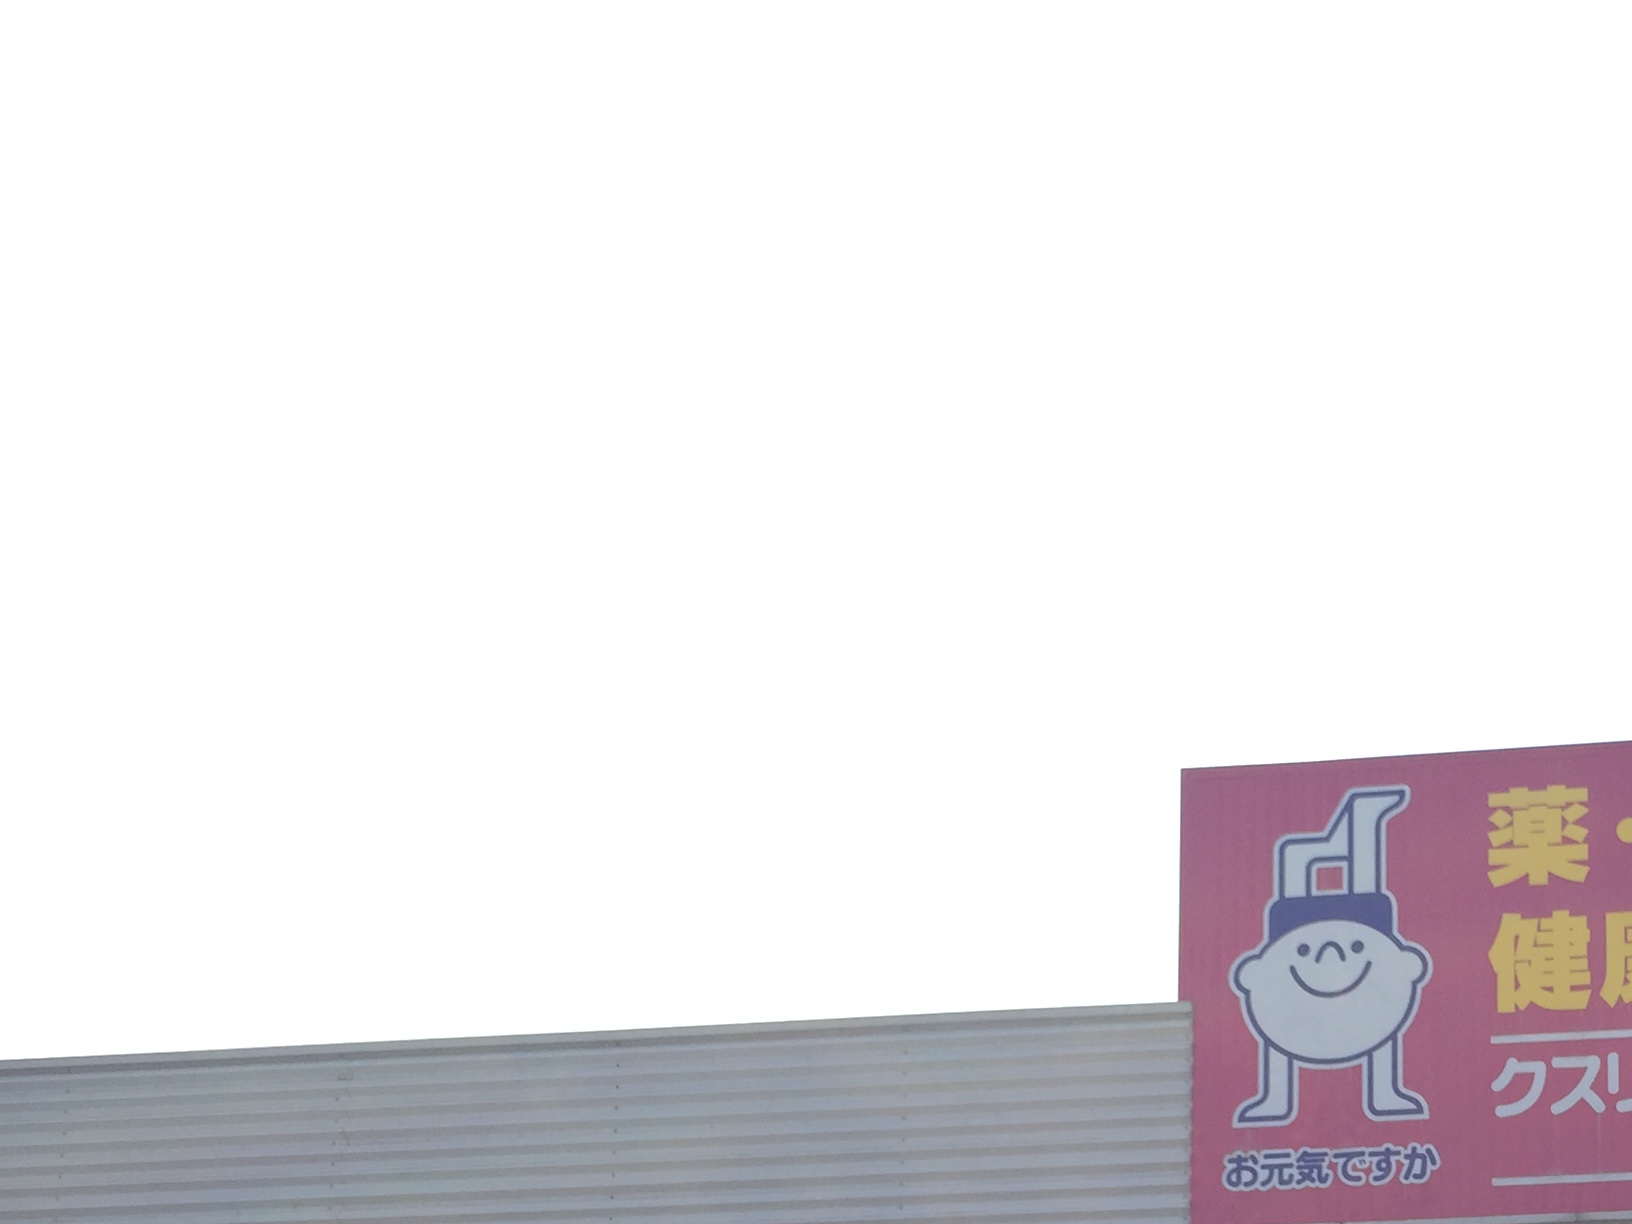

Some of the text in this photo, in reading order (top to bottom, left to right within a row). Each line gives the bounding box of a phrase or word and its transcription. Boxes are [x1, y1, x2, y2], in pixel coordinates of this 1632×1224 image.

[1222, 1144, 1440, 1191] お元気ですか
